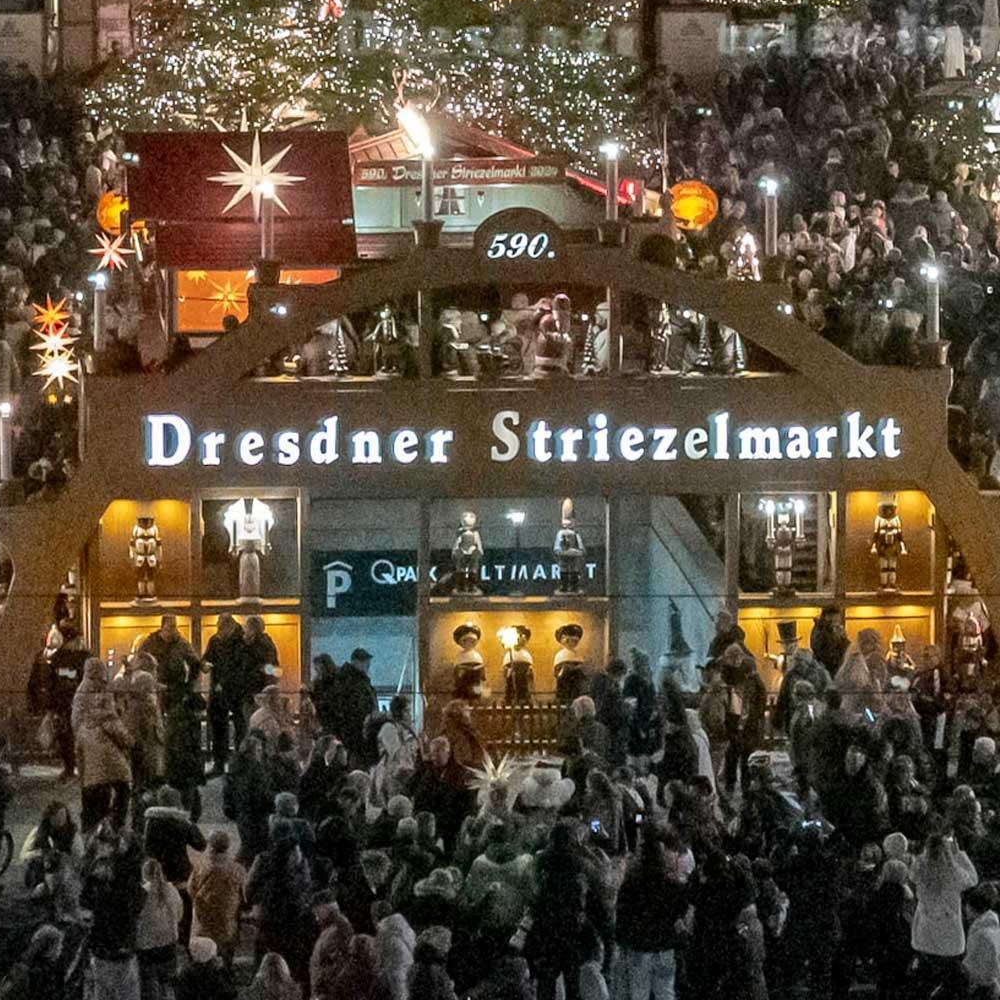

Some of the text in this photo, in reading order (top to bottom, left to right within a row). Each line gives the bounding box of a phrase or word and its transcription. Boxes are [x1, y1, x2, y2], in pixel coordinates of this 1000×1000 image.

[392, 165, 449, 181] Dresner
[451, 164, 527, 180] Striezelmarkt
[487, 232, 556, 259] 590.
[147, 410, 902, 468] Dresdner Striezelmarkt
